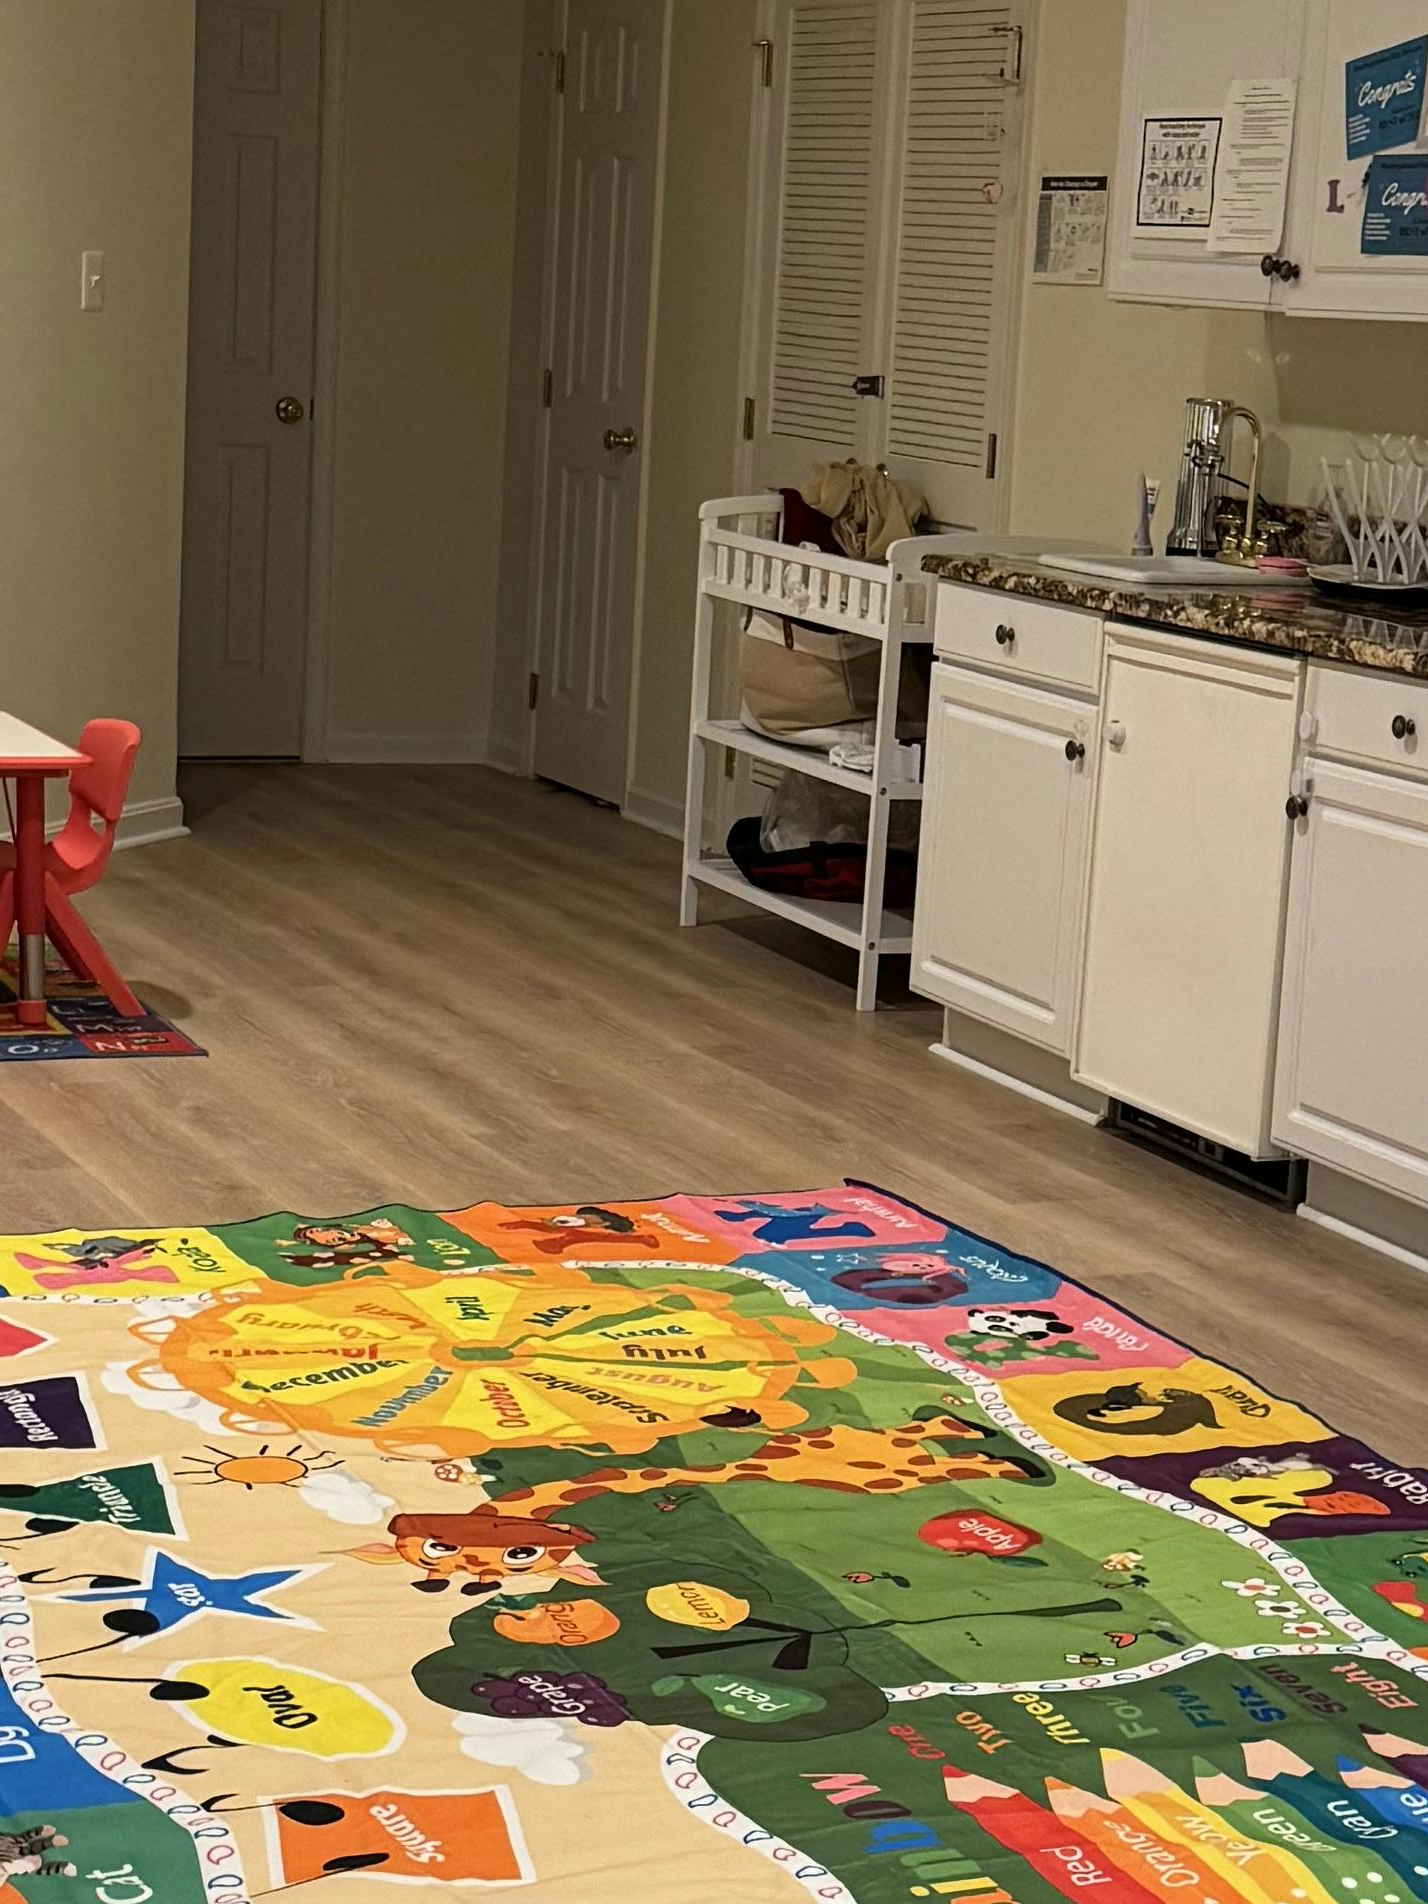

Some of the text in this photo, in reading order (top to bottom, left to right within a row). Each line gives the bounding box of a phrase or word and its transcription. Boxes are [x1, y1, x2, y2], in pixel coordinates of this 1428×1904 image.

[1327, 179, 1344, 214] L
[958, 1518, 1032, 1550] Apple
[518, 1674, 585, 1719] Grape
[714, 1682, 789, 1714] Pear
[1230, 1684, 1286, 1722] Six
[1331, 1661, 1418, 1708] Eight
[242, 1684, 318, 1729] Oval
[1012, 1689, 1090, 1743] Three
[955, 1711, 1011, 1753] Two
[369, 1803, 444, 1863] Square
[1040, 1846, 1111, 1885] Red
